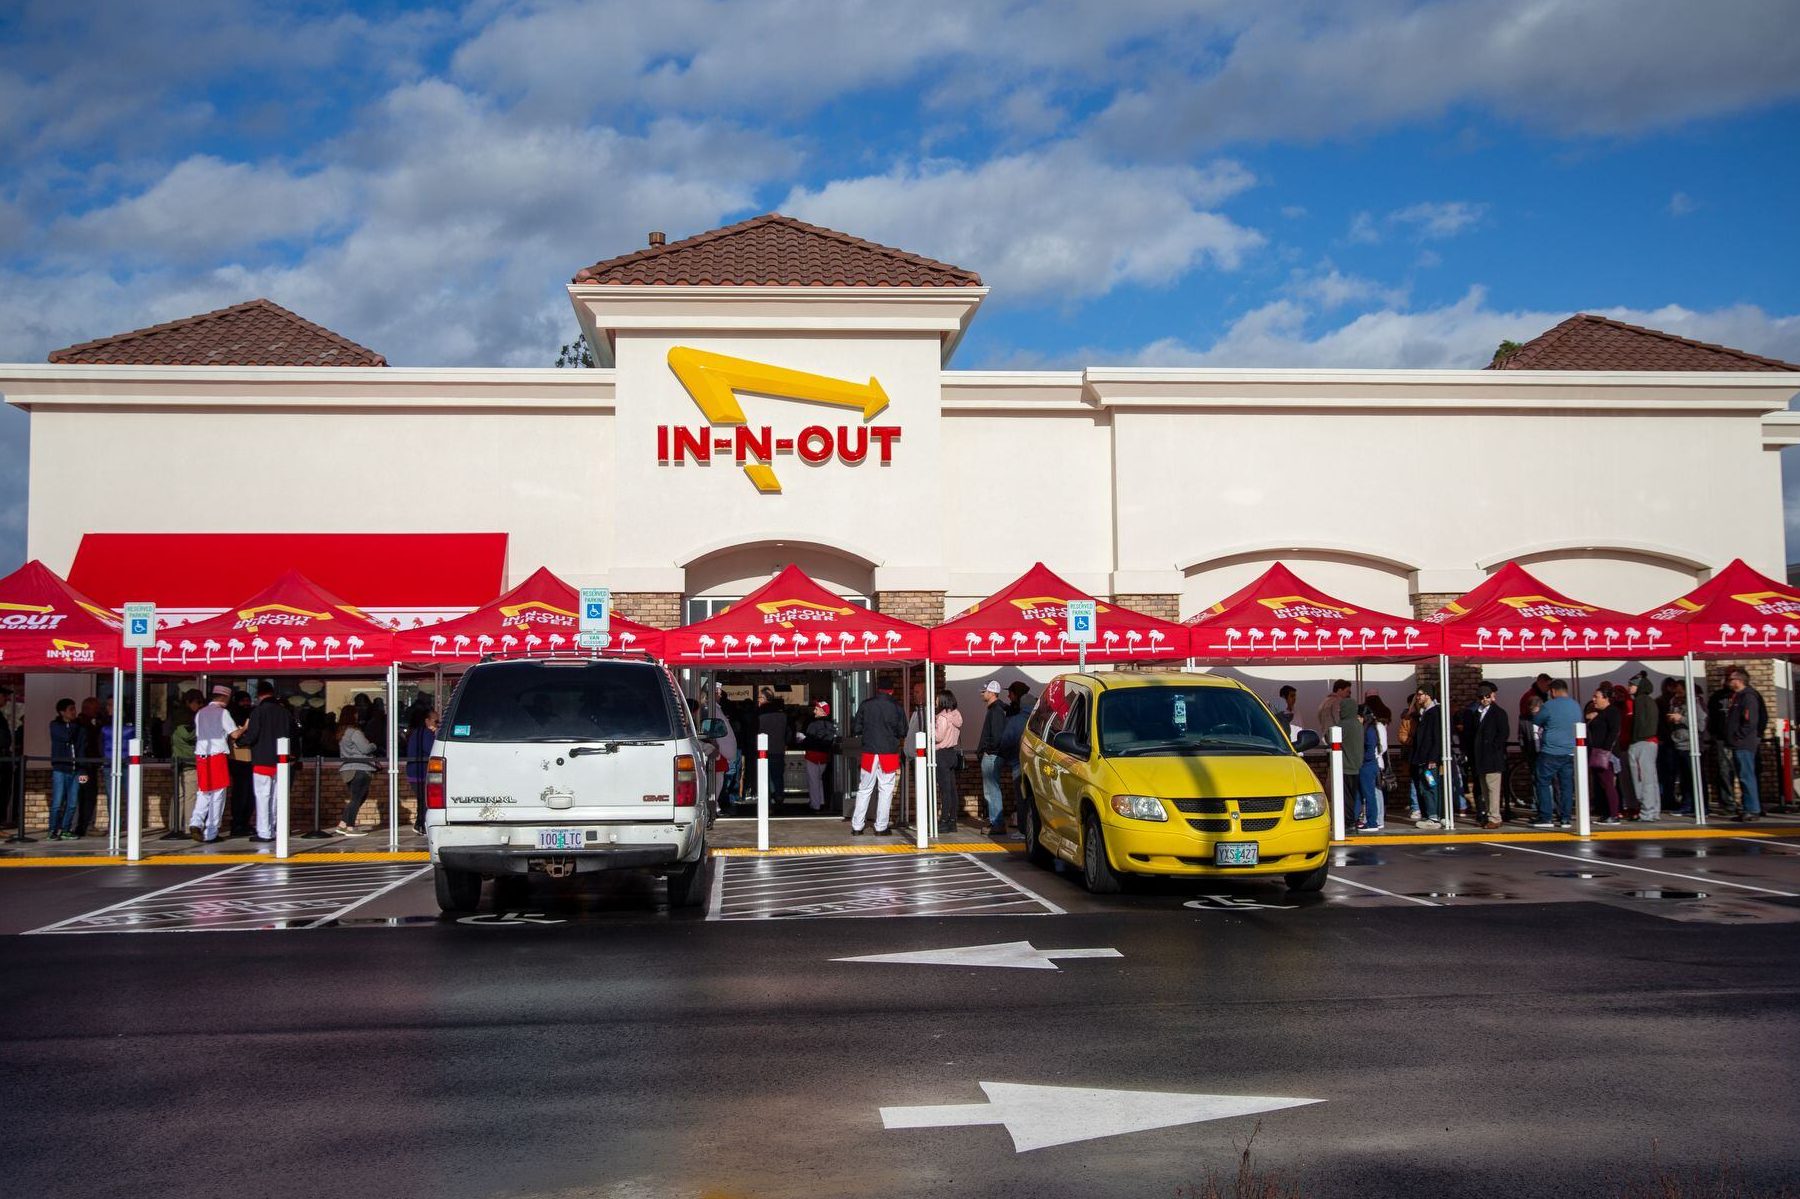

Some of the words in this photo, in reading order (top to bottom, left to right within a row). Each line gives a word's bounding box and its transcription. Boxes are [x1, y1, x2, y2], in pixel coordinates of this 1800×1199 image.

[657, 424, 902, 463] IN-N-OUT
[503, 611, 576, 622] IN-N-OUT
[764, 609, 835, 619] IN-N-OUT
[1023, 612, 1068, 620] BURG
[642, 794, 669, 802] GMC
